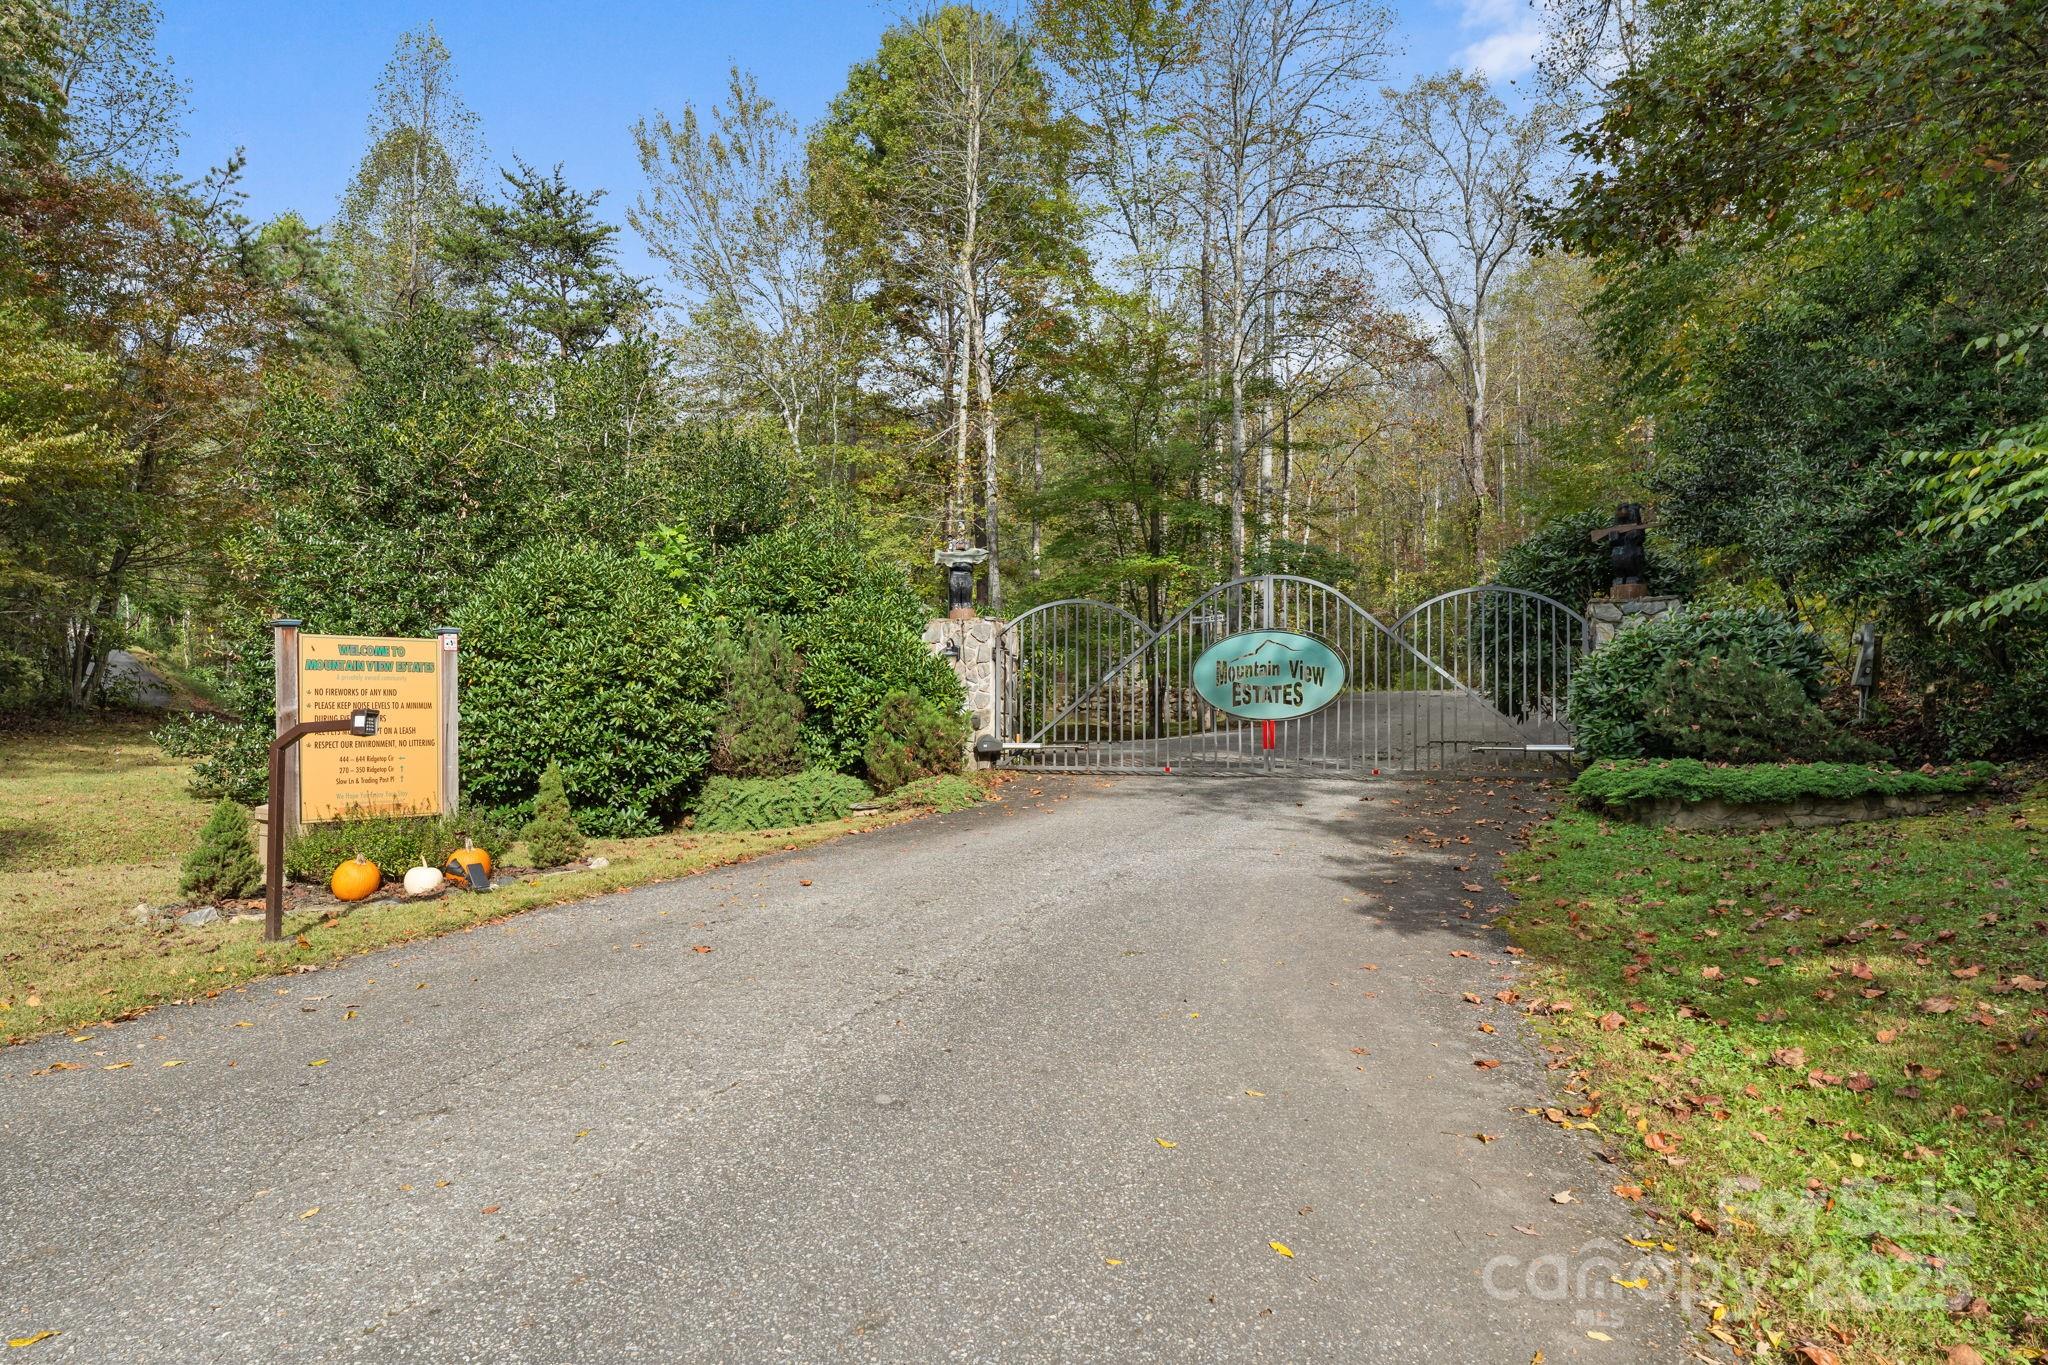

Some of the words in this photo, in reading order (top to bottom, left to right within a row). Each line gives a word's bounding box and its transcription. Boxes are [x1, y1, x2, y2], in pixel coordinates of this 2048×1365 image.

[338, 644, 390, 657] WELCOME
[391, 646, 405, 657] TO
[305, 659, 366, 672] MOUNTAIN
[366, 661, 394, 672] VIEW
[396, 662, 435, 673] ESTATES
[1216, 660, 1280, 686] Mountain
[1289, 660, 1325, 687] View
[1232, 682, 1304, 707] ESTATES
[353, 702, 369, 710] NOISE
[384, 727, 392, 735] ON
[314, 741, 338, 749] RESPECT
[341, 740, 352, 748] OUR
[354, 740, 397, 748] ENVIRONMENT,
[409, 739, 435, 747] LITTERING
[367, 766, 386, 774] Ridgetop
